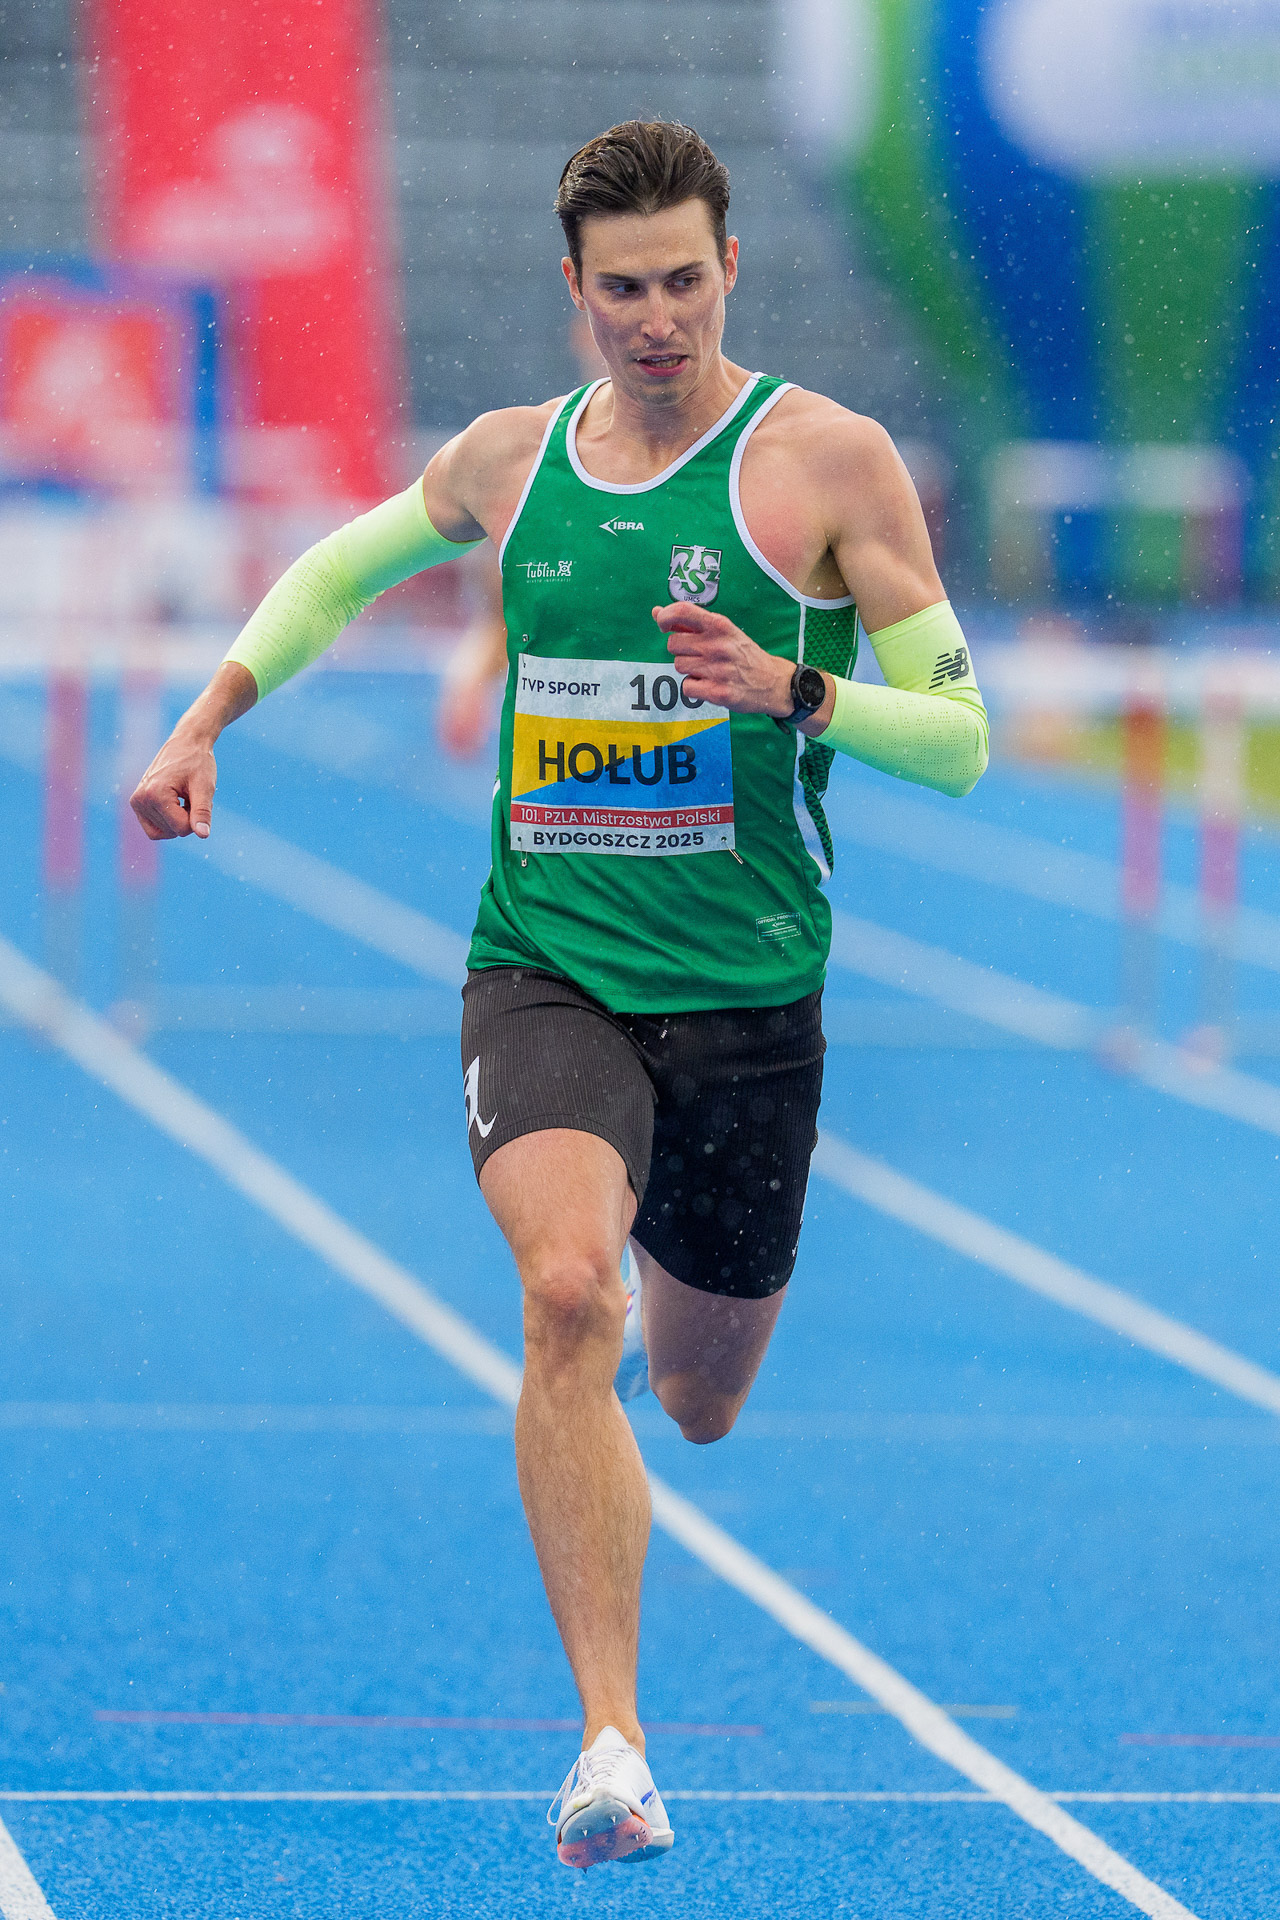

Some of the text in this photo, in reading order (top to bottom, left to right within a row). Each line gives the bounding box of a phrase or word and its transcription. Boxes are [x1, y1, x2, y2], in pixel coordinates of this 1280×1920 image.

[521, 677, 601, 697] TVP SPORT
[538, 739, 698, 786] HOŁUB
[520, 807, 721, 828] 101. PZLA Mistrzostwa Polski
[533, 831, 705, 849] BYDGOSZCZ 2025
